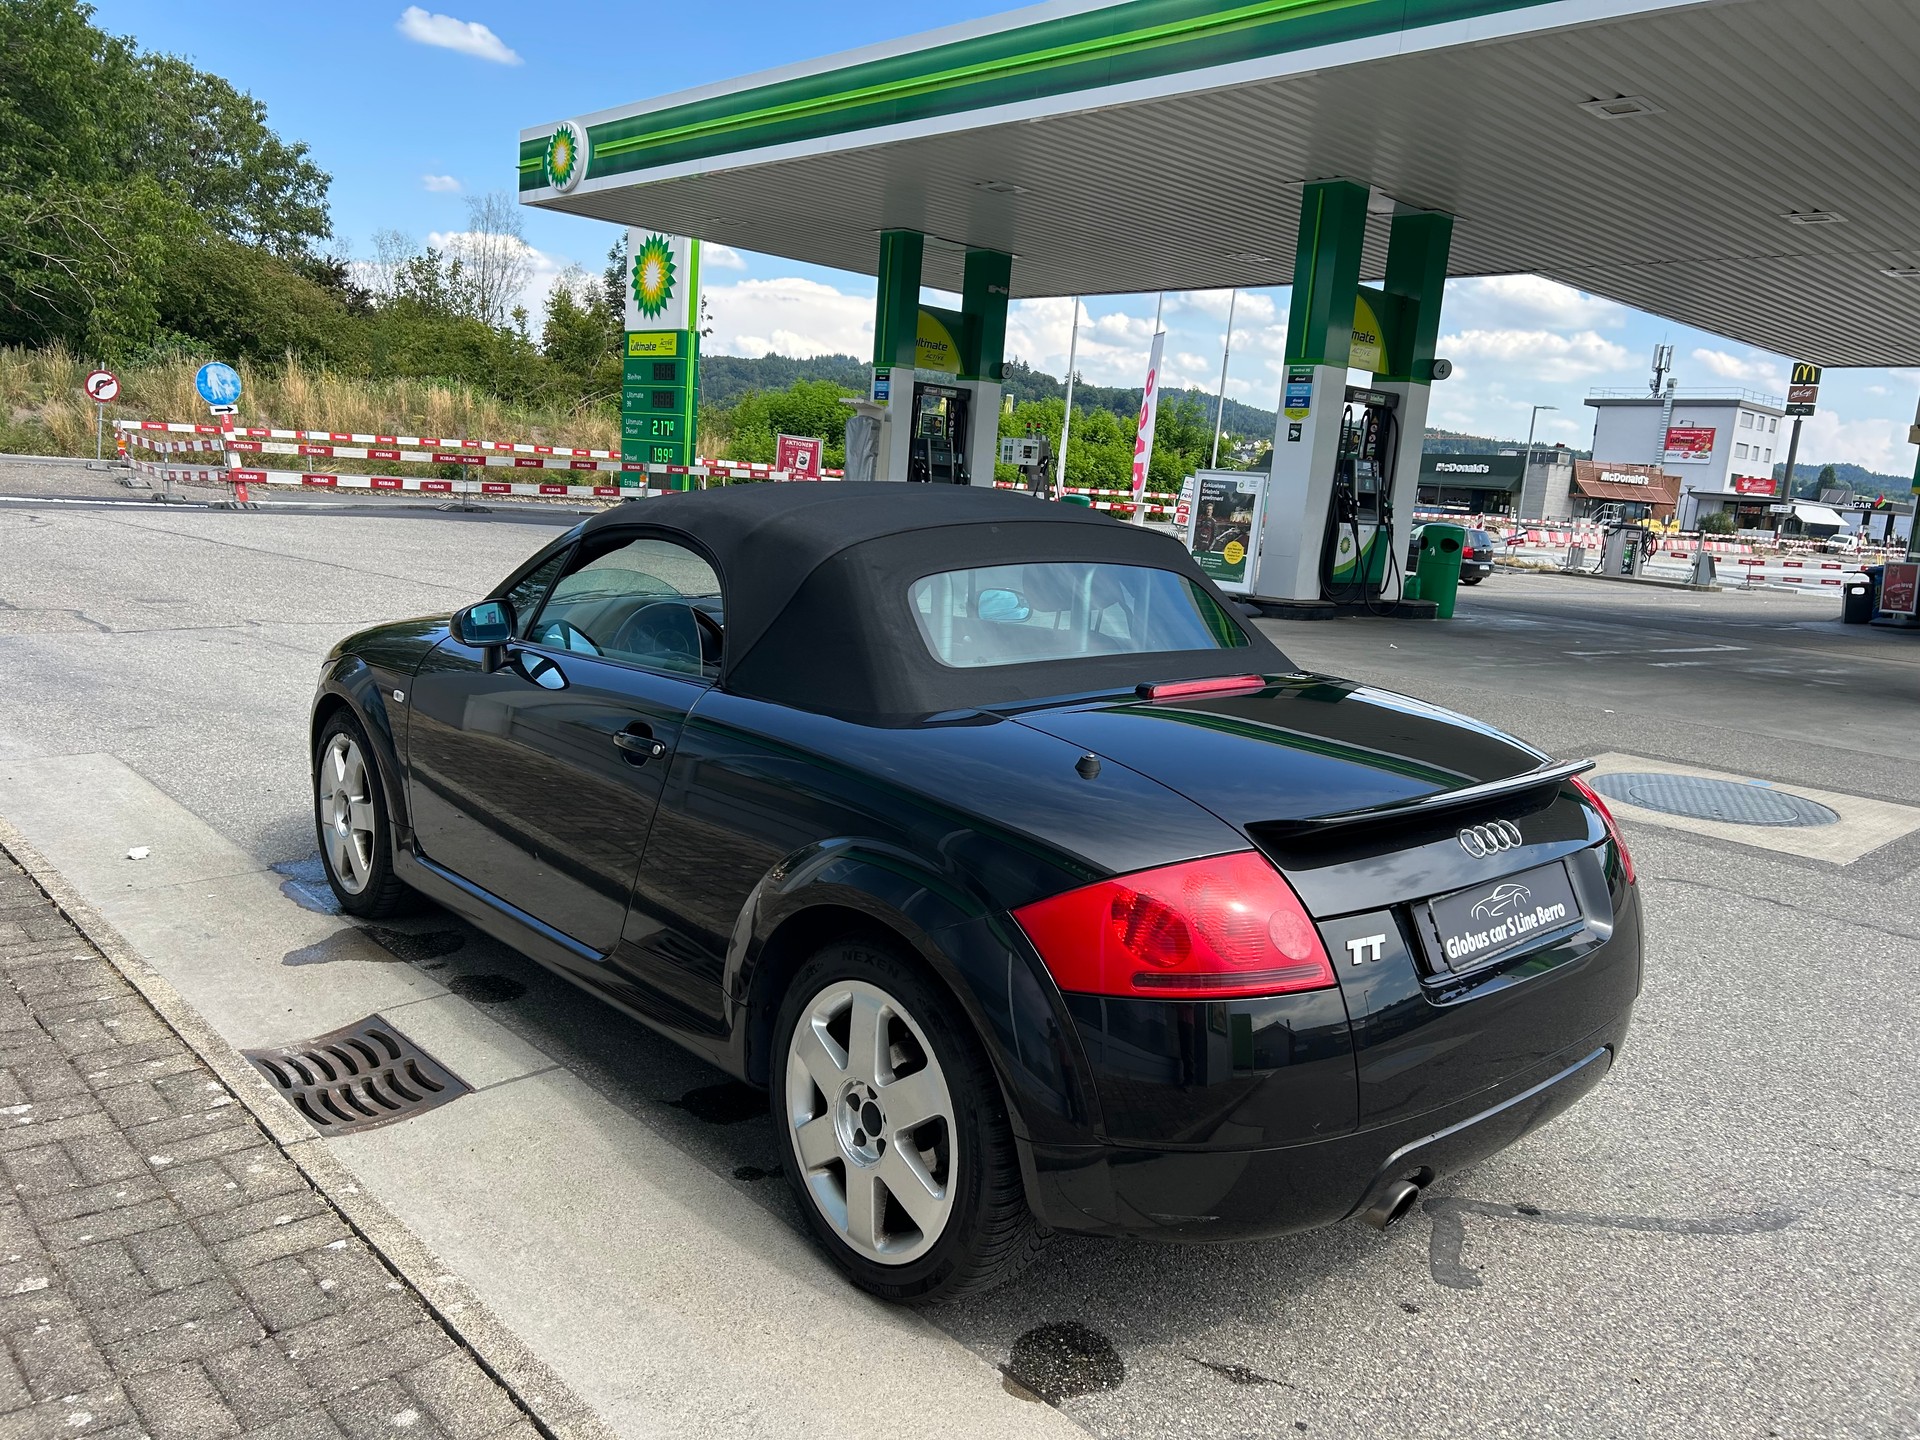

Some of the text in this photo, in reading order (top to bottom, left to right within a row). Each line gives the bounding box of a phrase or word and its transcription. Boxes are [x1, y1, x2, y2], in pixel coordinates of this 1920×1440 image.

[1005, 366, 1010, 376] 2
[1437, 364, 1446, 375] 4
[785, 440, 814, 448] AKTIONEN
[1435, 462, 1489, 474] McDonald's
[1600, 470, 1649, 486] McDonald's
[1446, 931, 1489, 960] Globus
[1489, 924, 1508, 941] car
[1515, 913, 1539, 935] Line
[1537, 902, 1566, 927] Berro
[1346, 933, 1386, 965] TT
[842, 951, 899, 979] NEXEN
